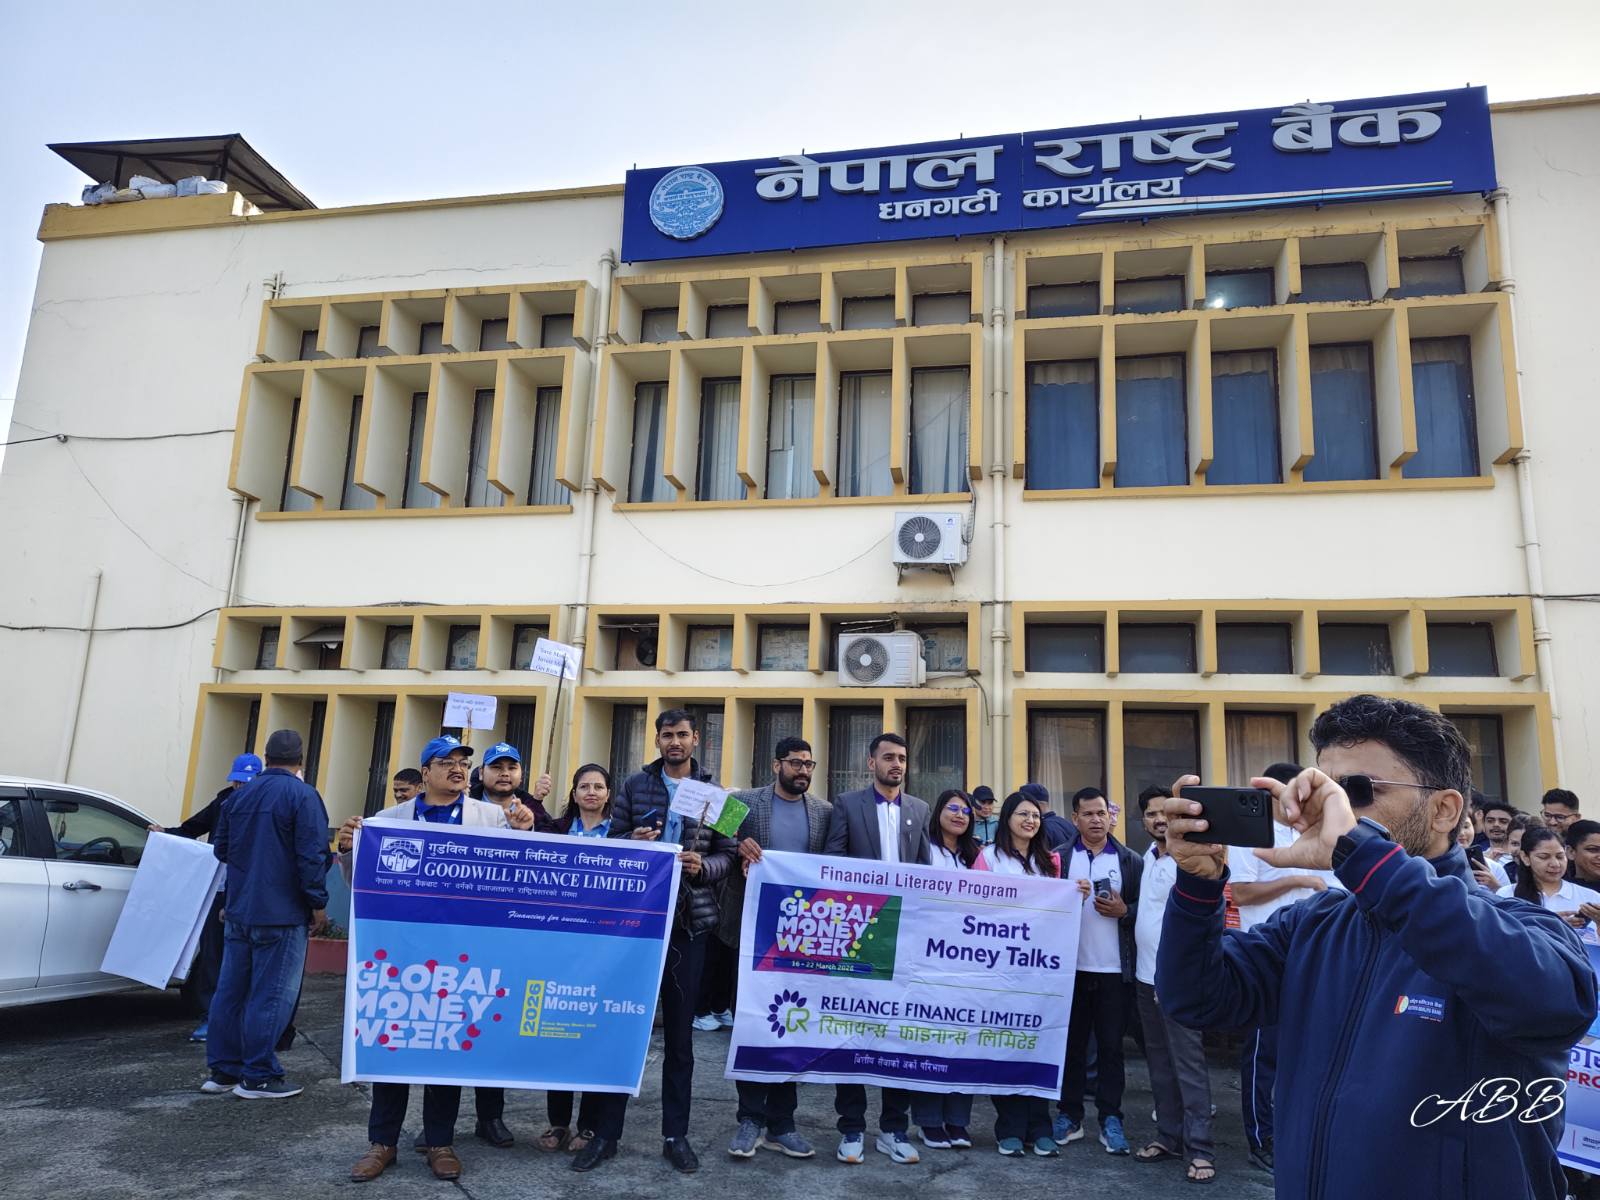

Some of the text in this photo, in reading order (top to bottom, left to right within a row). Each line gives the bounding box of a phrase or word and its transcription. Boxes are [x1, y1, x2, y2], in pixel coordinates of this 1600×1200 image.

[755, 101, 1448, 201] नेपाल राष्ट्र बैंक
[878, 176, 1184, 221] धनगढी कार्यालय
[428, 841, 468, 856] गुडविल
[473, 847, 520, 860] फाइनान्स
[525, 848, 569, 864] लिमिटेड
[573, 852, 614, 868] (वित्तीय
[424, 862, 647, 893] GOODWILL FINANCE LIMITED
[820, 865, 1018, 899] Financial Literacy Program
[508, 910, 546, 922] Financing
[547, 914, 559, 923] for
[780, 897, 879, 923] GLOBAL
[776, 916, 870, 941] MONEY
[962, 915, 1031, 941] Smart
[775, 932, 852, 958] WEEK
[925, 938, 1061, 971] Money Talks
[355, 960, 511, 997] GLOBAL
[815, 963, 837, 971] March
[545, 980, 597, 998] Smart
[523, 983, 542, 1034] 2026
[544, 996, 646, 1016] Money Talks
[820, 995, 1043, 1029] RELIANCE FINANCE LIMITED
[819, 1015, 1039, 1050] रिलायन्स फाइनान्स लिमिटेड
